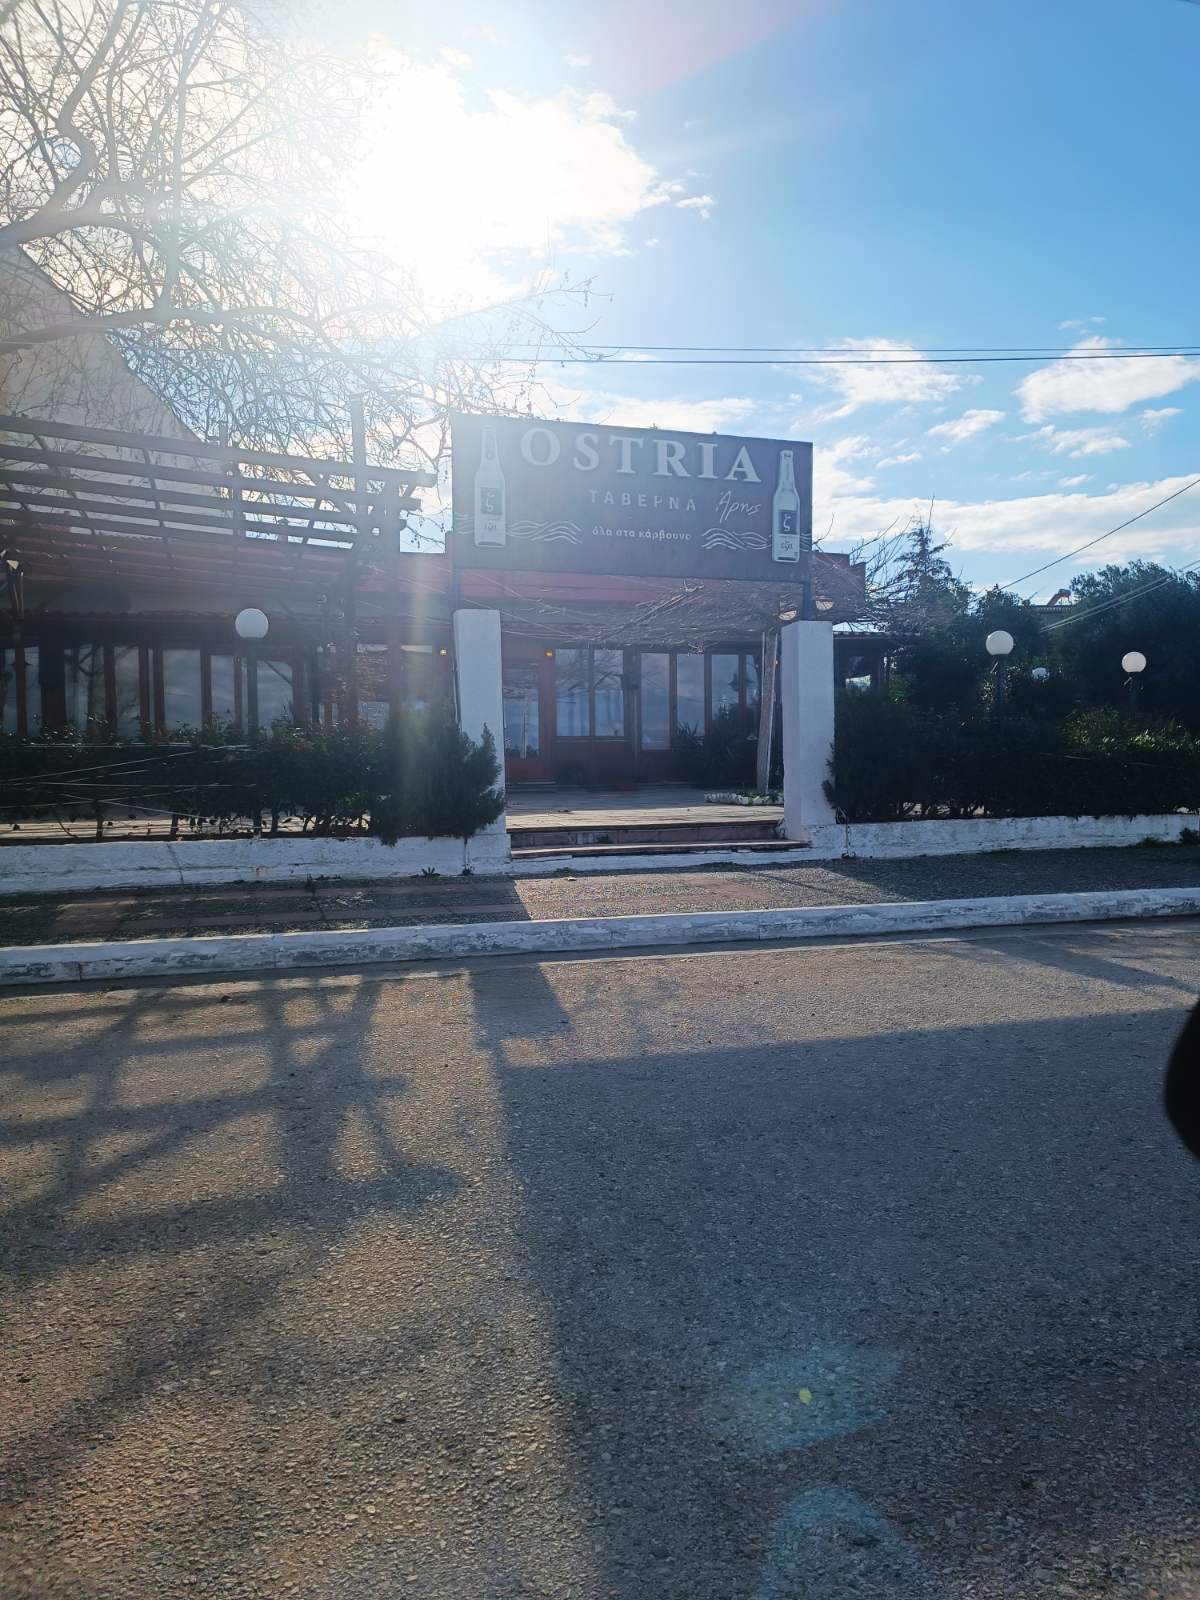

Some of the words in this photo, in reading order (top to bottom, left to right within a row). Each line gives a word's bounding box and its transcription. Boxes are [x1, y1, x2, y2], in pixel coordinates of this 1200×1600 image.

[520, 427, 762, 483] OSTRIA
[588, 489, 697, 512] ΤΑΒΕΡΝΑ
[592, 525, 613, 537] όλα
[616, 529, 635, 538] στα
